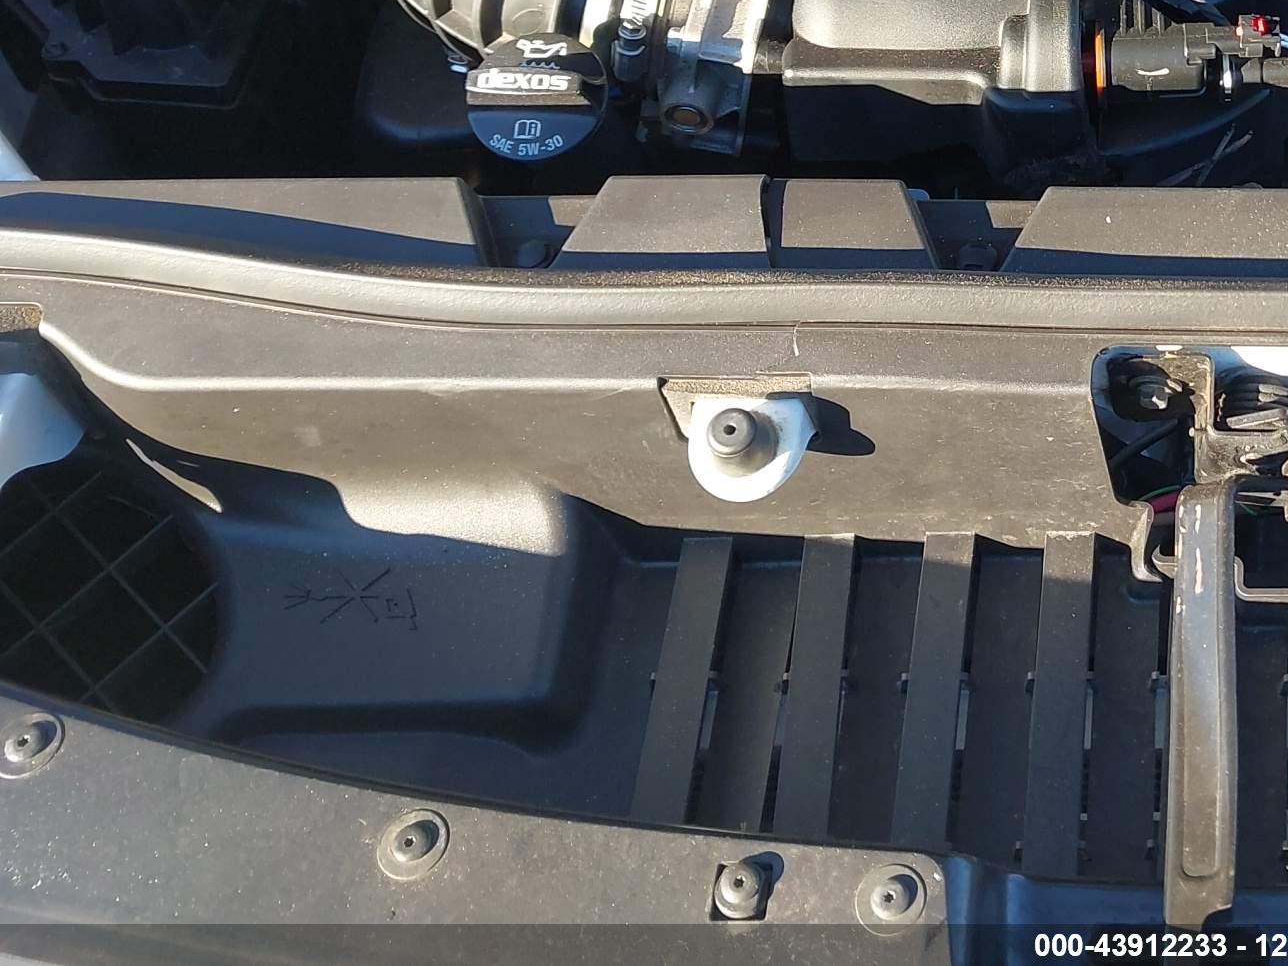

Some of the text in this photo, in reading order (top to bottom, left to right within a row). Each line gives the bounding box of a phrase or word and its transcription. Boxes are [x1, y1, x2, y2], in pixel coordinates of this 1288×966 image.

[477, 68, 572, 91] dexos
[489, 134, 564, 156] SAE 5W-30
